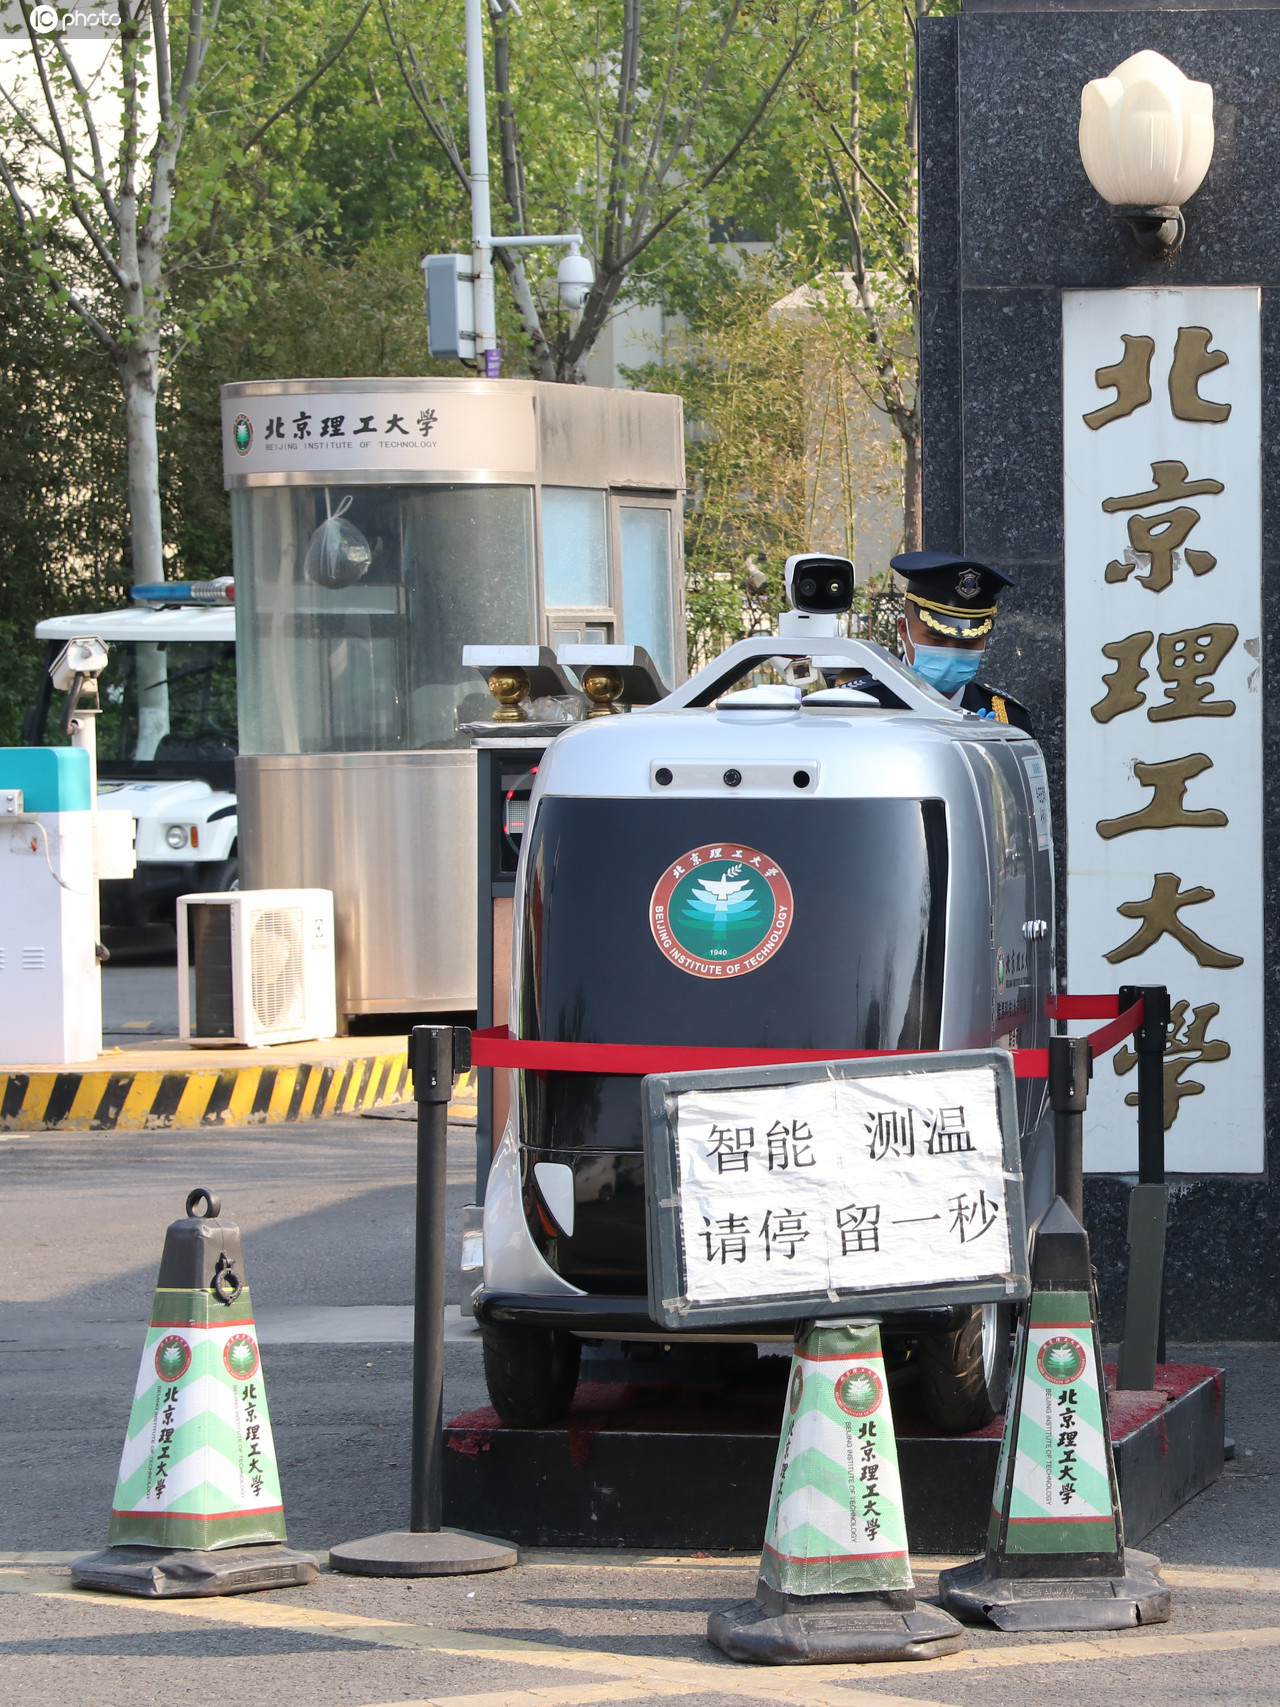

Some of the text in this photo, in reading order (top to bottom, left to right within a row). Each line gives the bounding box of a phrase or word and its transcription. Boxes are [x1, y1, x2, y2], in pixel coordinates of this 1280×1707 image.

[265, 443, 298, 451] BEIJING
[655, 905, 788, 975] BEIJING INSTITUTE OF TECHNOLOGY
[706, 1105, 977, 1175] 智能 测温
[698, 1189, 999, 1265] 请停留一秒
[847, 1450, 855, 1483] INSTITUTE
[1045, 1450, 1052, 1459] OF
[849, 1485, 855, 1495] OF
